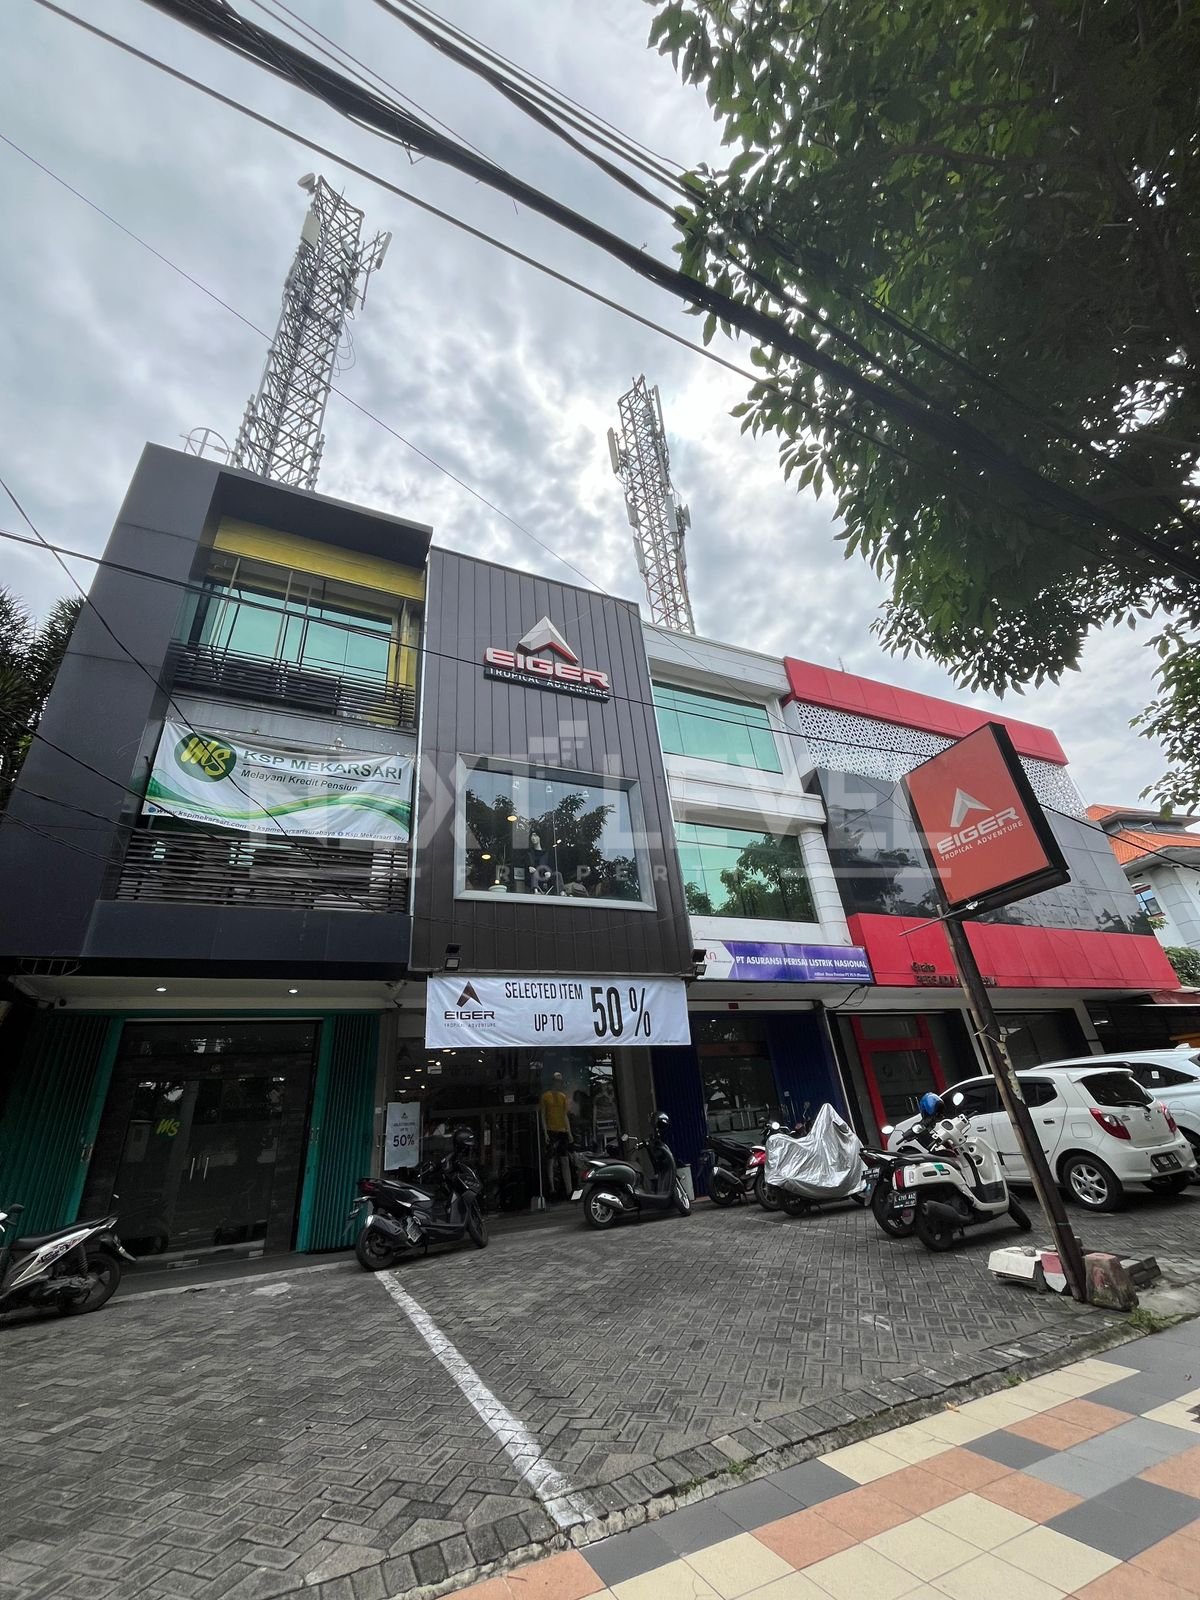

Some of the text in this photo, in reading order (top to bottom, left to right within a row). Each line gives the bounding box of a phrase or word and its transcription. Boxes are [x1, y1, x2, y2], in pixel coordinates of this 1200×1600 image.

[485, 647, 610, 690] EIGER
[243, 750, 402, 779] KSP MEKARSARI
[241, 769, 358, 792] Melayani Kredit Pensiun
[937, 807, 1019, 854] EIGER
[940, 821, 1024, 861] TROPICAL ADVENTURE
[736, 956, 745, 964] PT
[746, 956, 782, 965] ASURANSI
[809, 958, 833, 967] LISTRIK
[834, 959, 867, 968] NASIONAL
[505, 982, 583, 1000] SELECTED ITEM
[444, 1011, 495, 1020] EIGER
[534, 1014, 564, 1032] UP TO
[590, 986, 651, 1037] 50%
[393, 1134, 415, 1147] 50%
